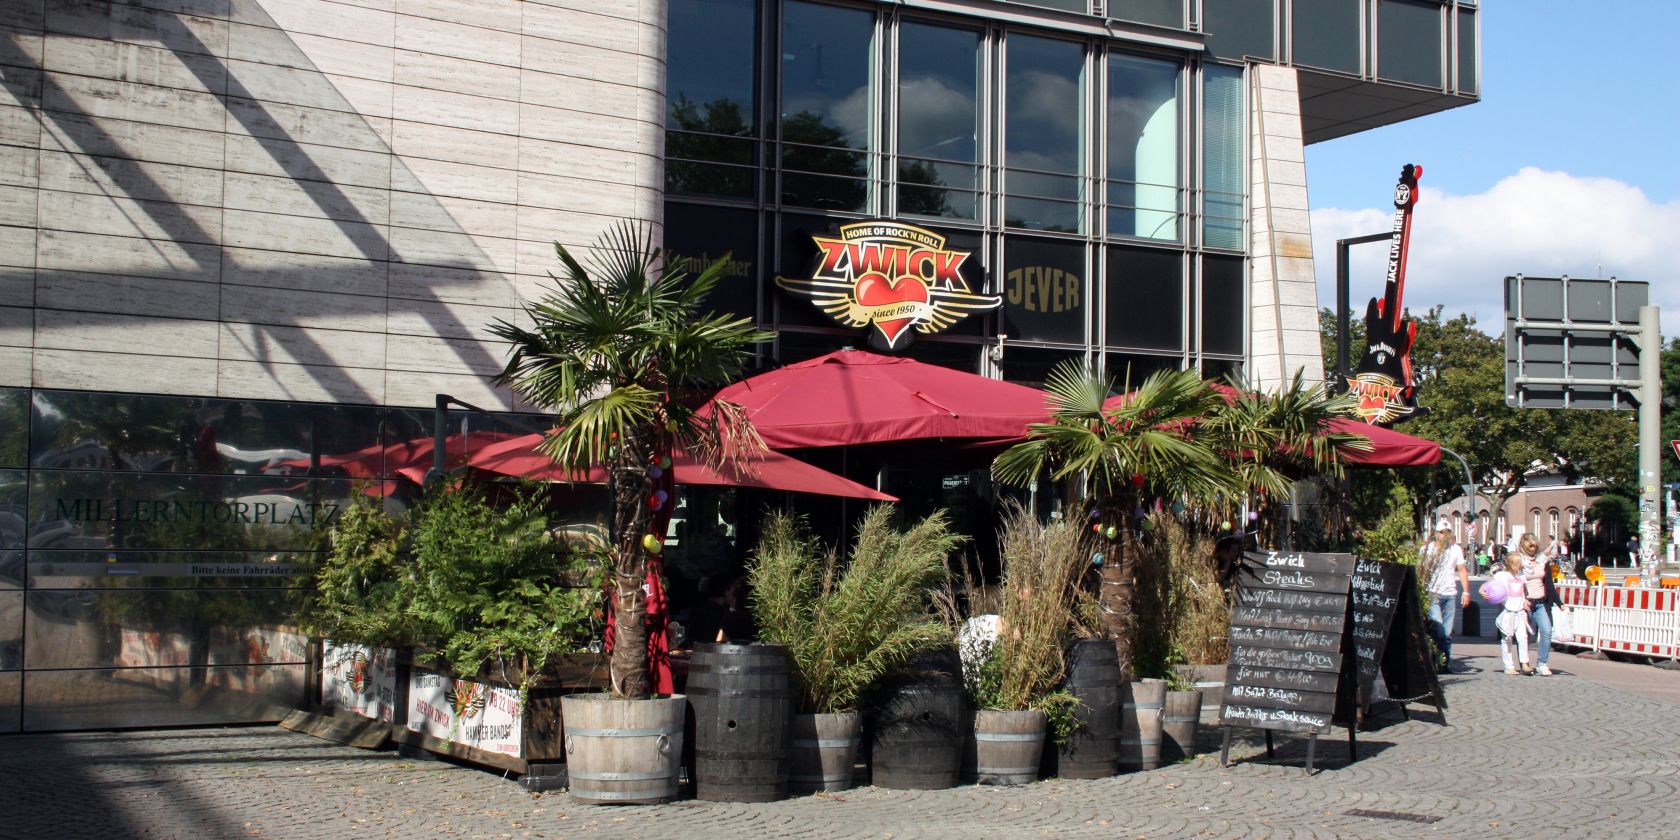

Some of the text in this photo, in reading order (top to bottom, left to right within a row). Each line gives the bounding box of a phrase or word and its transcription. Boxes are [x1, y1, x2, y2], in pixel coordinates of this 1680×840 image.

[845, 228, 873, 239] HOME
[873, 227, 885, 236] OF
[918, 234, 938, 248] ROLL
[1388, 208, 1405, 283] JACK LIVES HERE
[812, 236, 971, 293] ZWICK
[1007, 266, 1080, 313] JEVER
[872, 305, 916, 318] since 1950
[1346, 378, 1404, 406] ZWICK
[55, 497, 340, 525] MILLERNTORPLATZ
[192, 565, 214, 575] Bitte
[217, 565, 241, 575] keine
[243, 565, 289, 575] Fahrräder
[1263, 571, 1315, 588] Steaks
[1236, 666, 1252, 681] für
[1254, 670, 1271, 679] nur
[1274, 671, 1285, 682] €
[416, 698, 428, 716] HIER
[427, 706, 434, 721] IM
[434, 708, 450, 730] ZWICK
[489, 691, 498, 709] AB
[498, 694, 506, 712] 22
[507, 698, 520, 716] UHR
